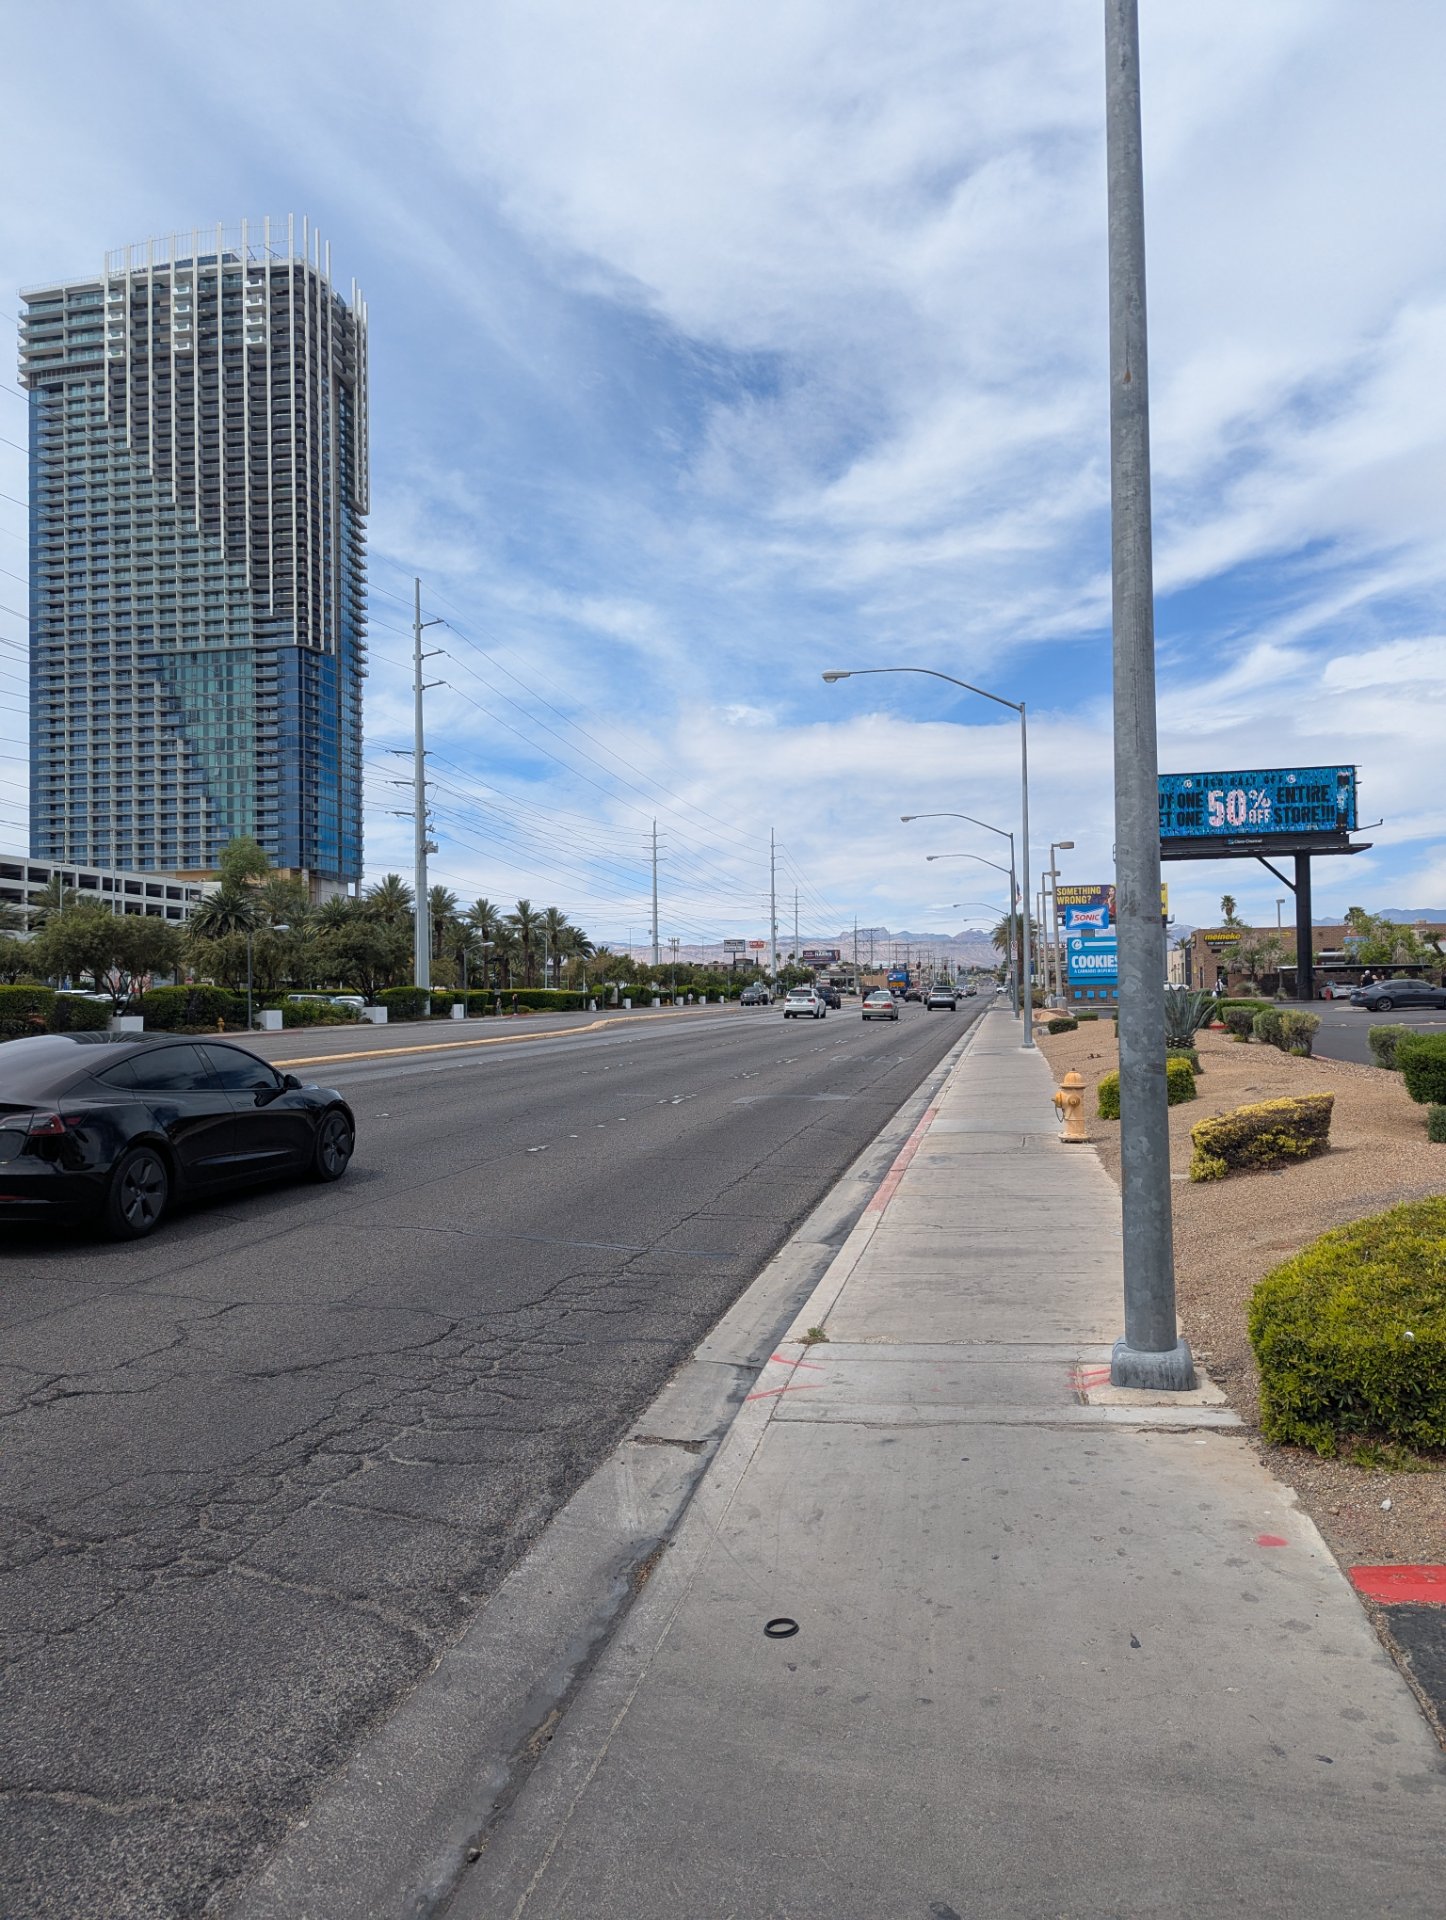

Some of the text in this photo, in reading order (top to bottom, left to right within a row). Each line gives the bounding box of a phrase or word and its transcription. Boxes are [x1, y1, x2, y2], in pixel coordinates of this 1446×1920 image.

[1158, 791, 1204, 809] UY ONE
[1277, 785, 1331, 804] ENTIRE
[1159, 811, 1204, 827] ET ONE
[1248, 809, 1271, 824] OFF
[1274, 805, 1335, 824] STORE!!!
[1057, 886, 1101, 896] SOMETHING
[1057, 895, 1092, 905] WRONG?
[1074, 914, 1100, 922] SONIC
[1205, 932, 1241, 941] meineke
